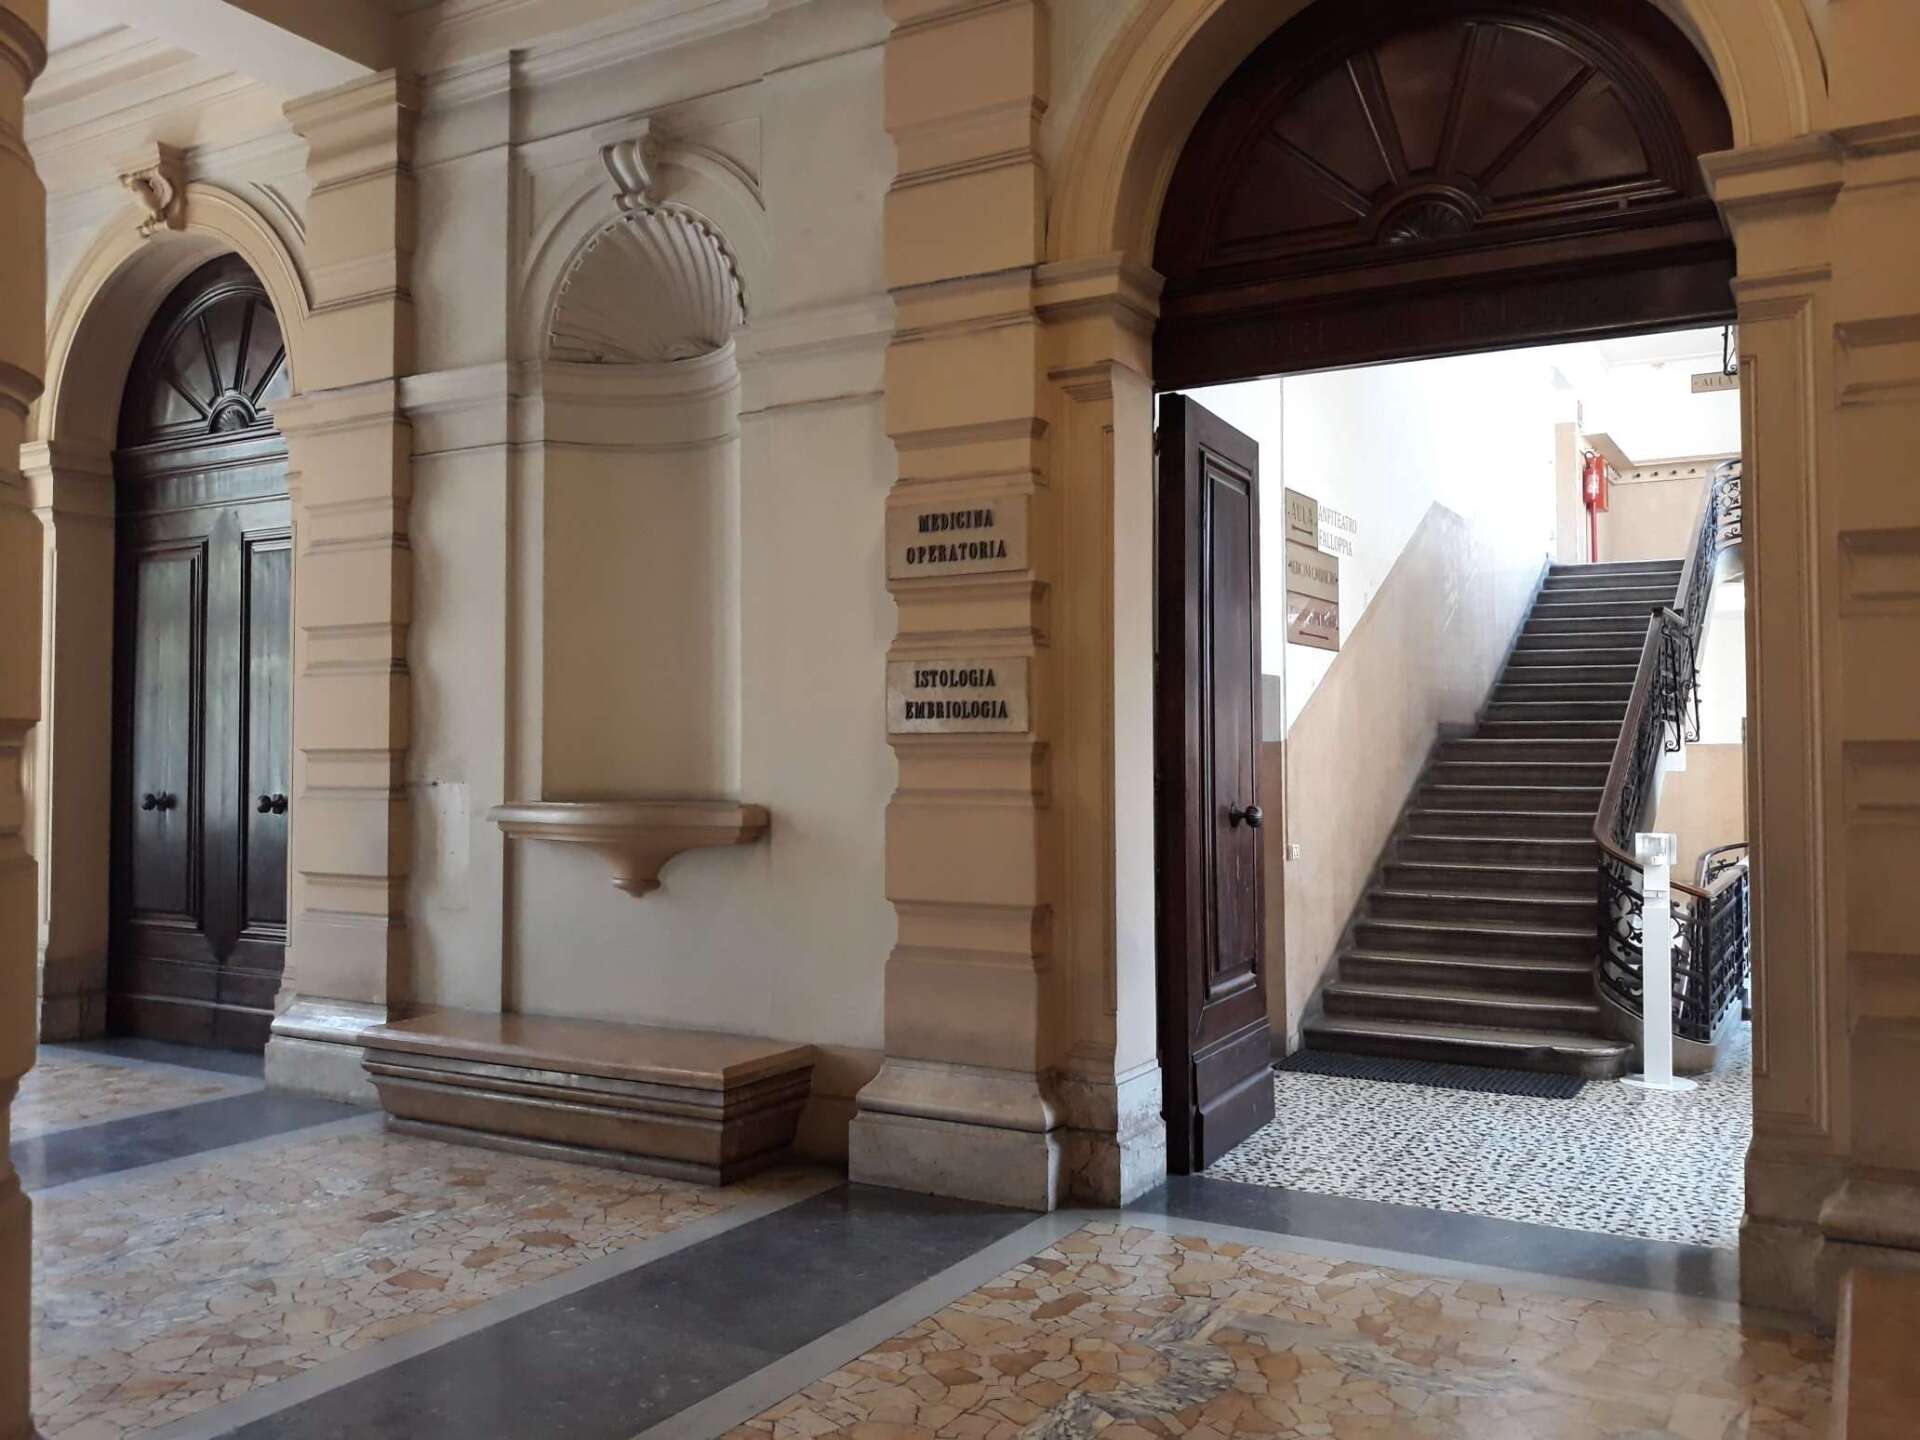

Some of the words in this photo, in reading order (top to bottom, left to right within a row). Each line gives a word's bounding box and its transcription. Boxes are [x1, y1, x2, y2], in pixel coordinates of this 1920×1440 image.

[918, 508, 994, 534] MEDICINA
[906, 540, 1008, 565] OPERATORIA
[914, 668, 996, 689] ISTOLOGIA
[905, 700, 1009, 720] EMBRIOLOGIA
